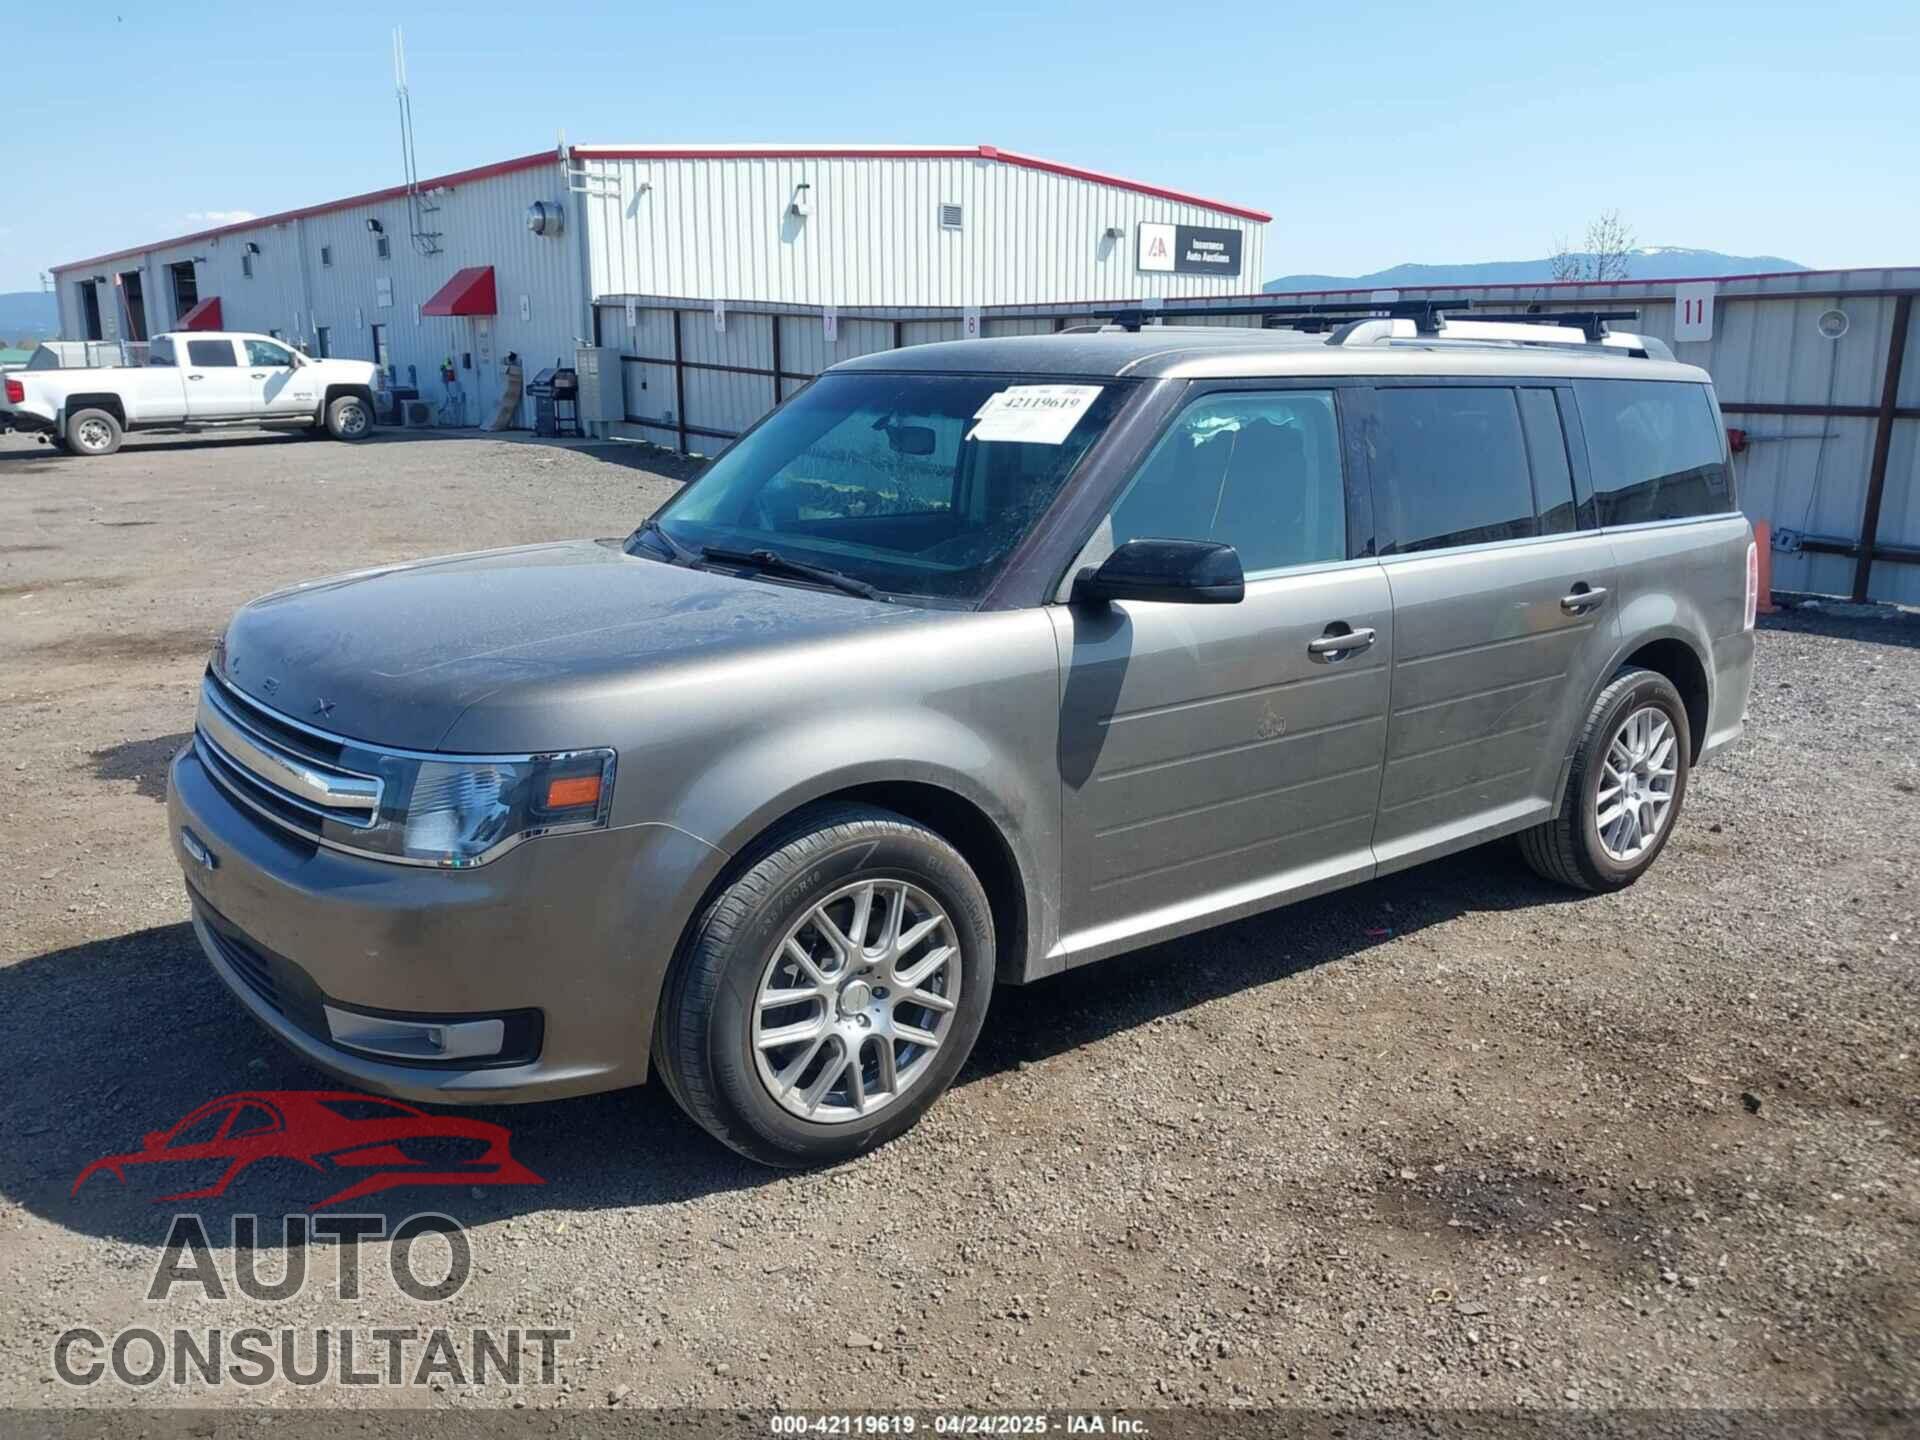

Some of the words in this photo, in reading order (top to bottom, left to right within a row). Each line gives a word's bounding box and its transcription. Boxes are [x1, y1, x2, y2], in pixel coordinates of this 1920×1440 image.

[1186, 250, 1202, 261] Auto
[1684, 299, 1703, 325] 11
[826, 316, 834, 331] 7
[968, 317, 976, 334] 8
[1005, 396, 1081, 409] 42119619
